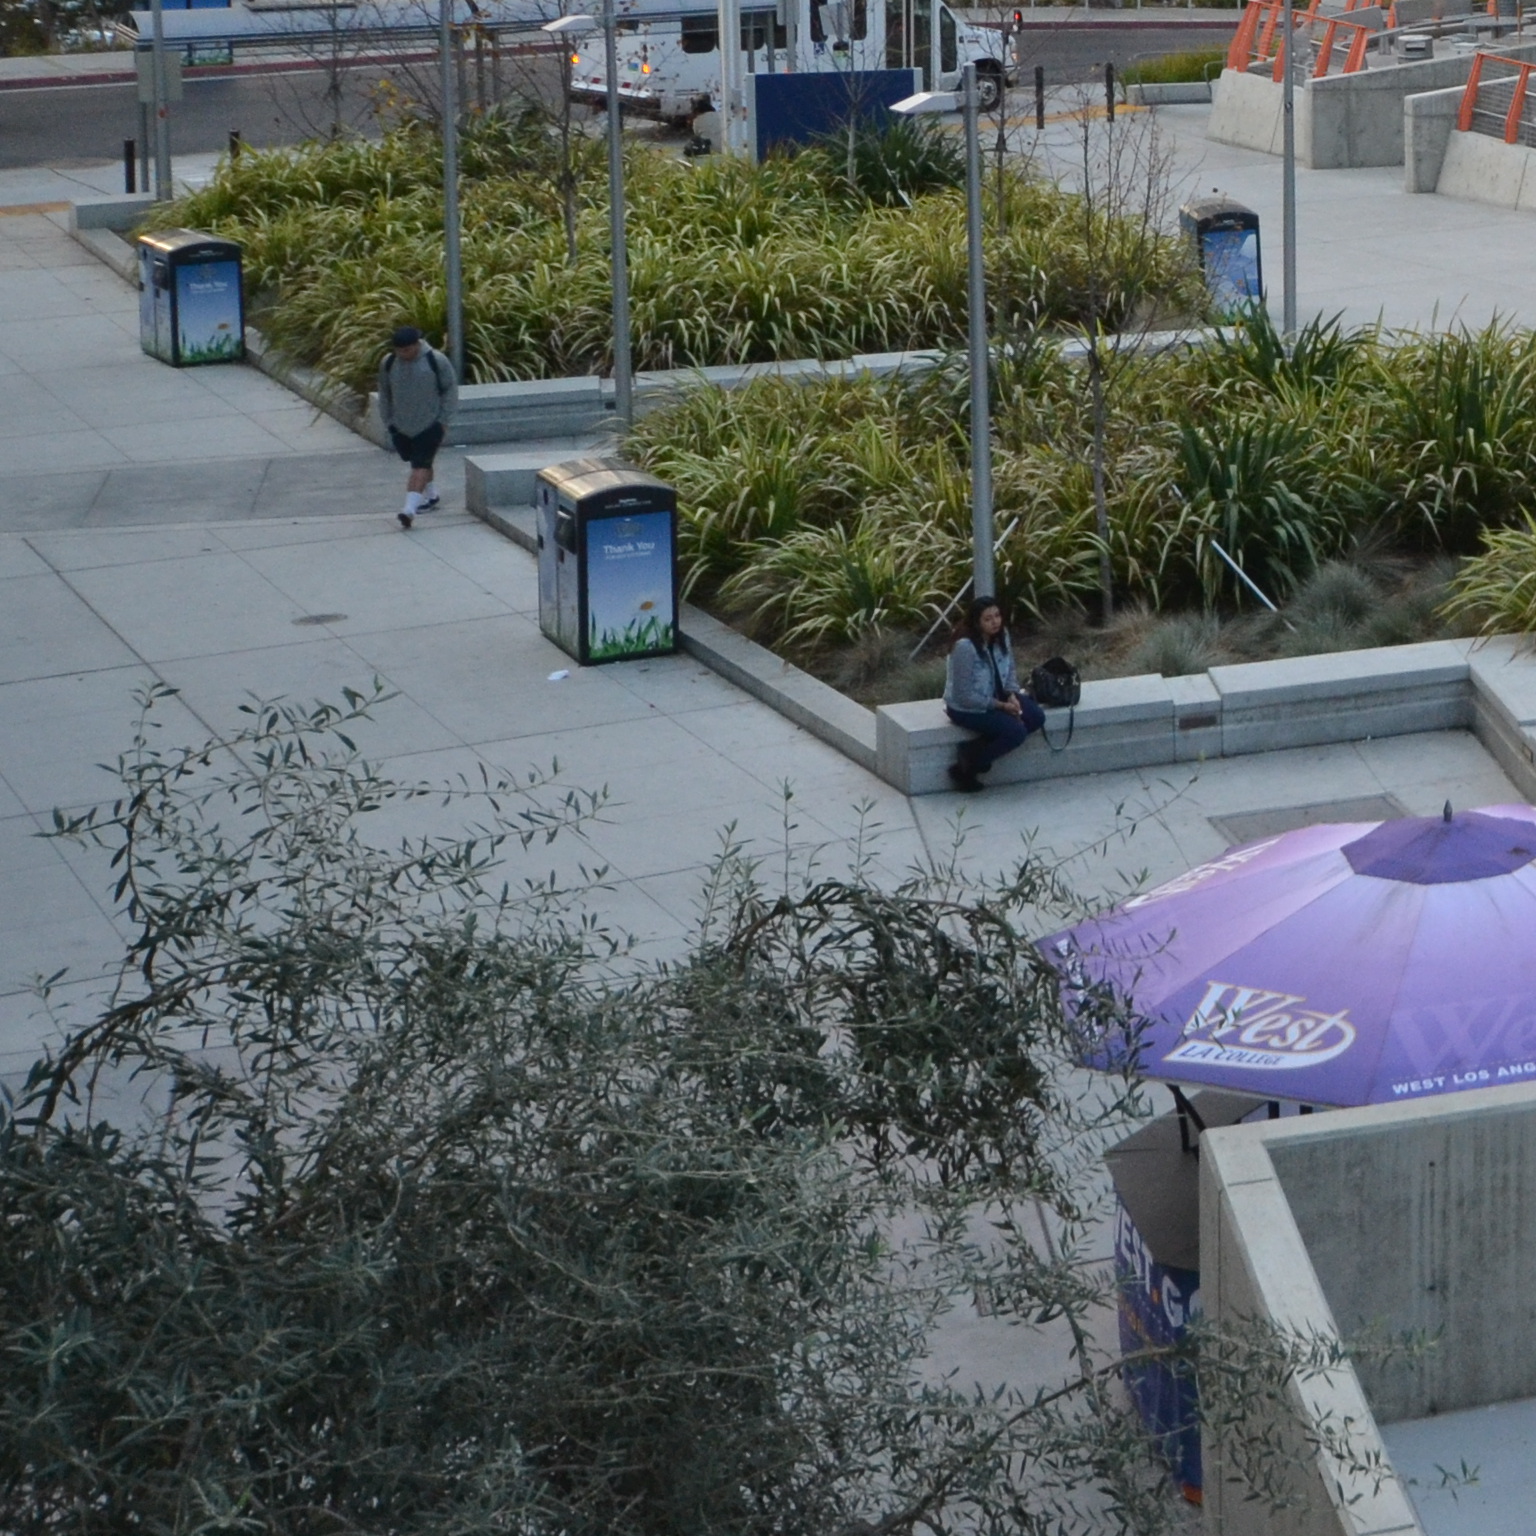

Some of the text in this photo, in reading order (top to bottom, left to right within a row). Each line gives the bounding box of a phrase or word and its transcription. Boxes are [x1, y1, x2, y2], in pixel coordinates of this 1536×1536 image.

[604, 541, 655, 554] Thank You
[1182, 980, 1351, 1052] West
[1178, 1044, 1286, 1066] LA COLLEGE
[1392, 1076, 1446, 1096] WEST
[1453, 1069, 1490, 1085] LOS
